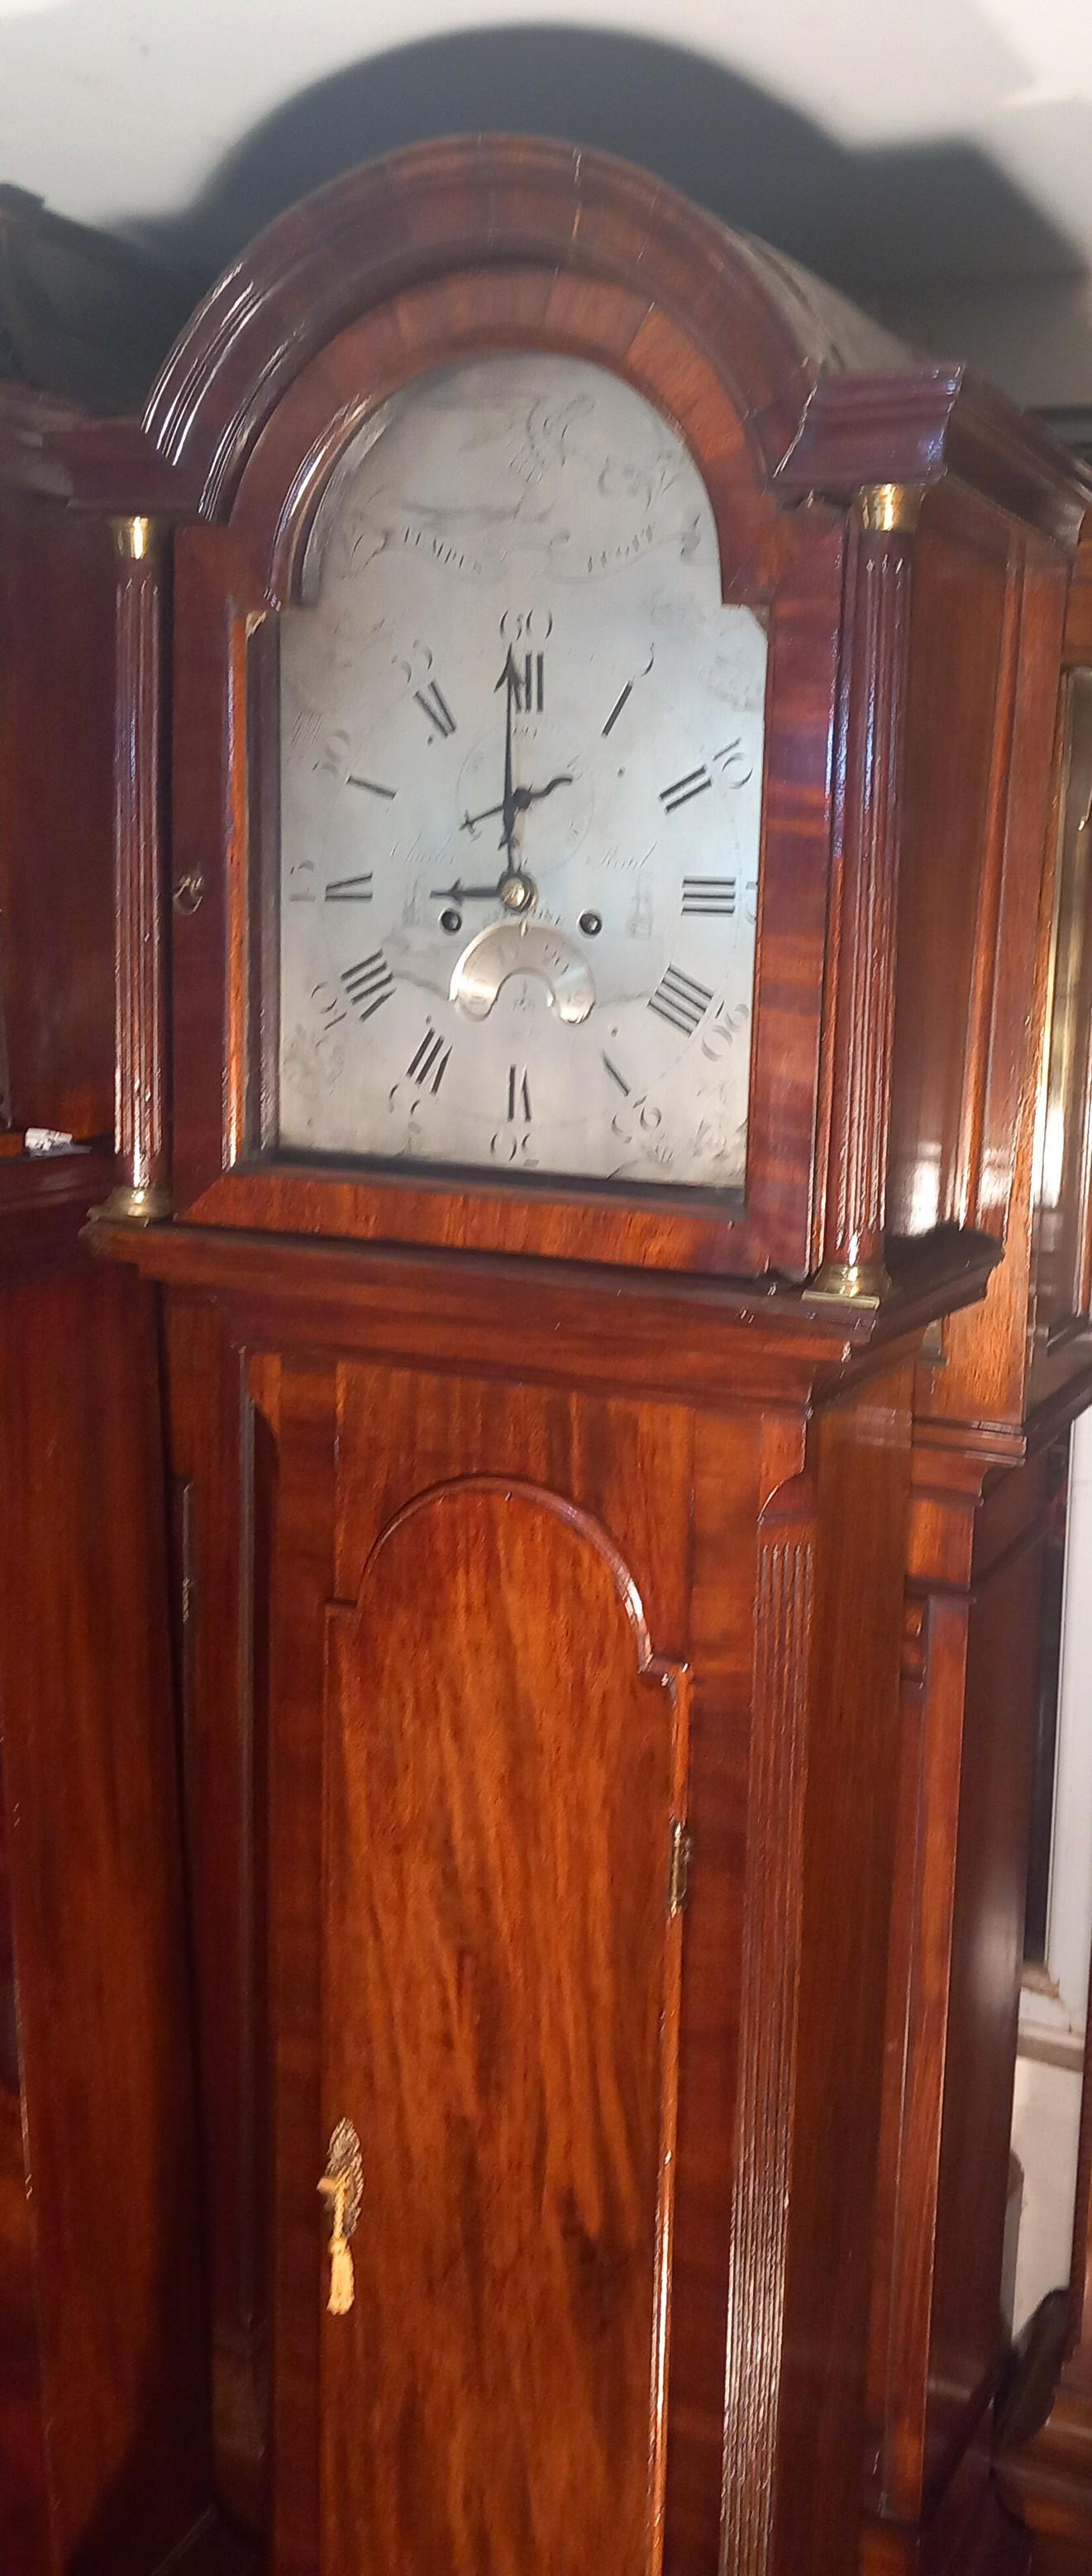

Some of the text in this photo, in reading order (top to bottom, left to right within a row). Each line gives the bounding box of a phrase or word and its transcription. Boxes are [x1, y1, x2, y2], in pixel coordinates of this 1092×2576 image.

[499, 608, 552, 642] 60
[658, 763, 712, 814] II
[681, 876, 736, 918] III
[646, 962, 715, 1038] IIII
